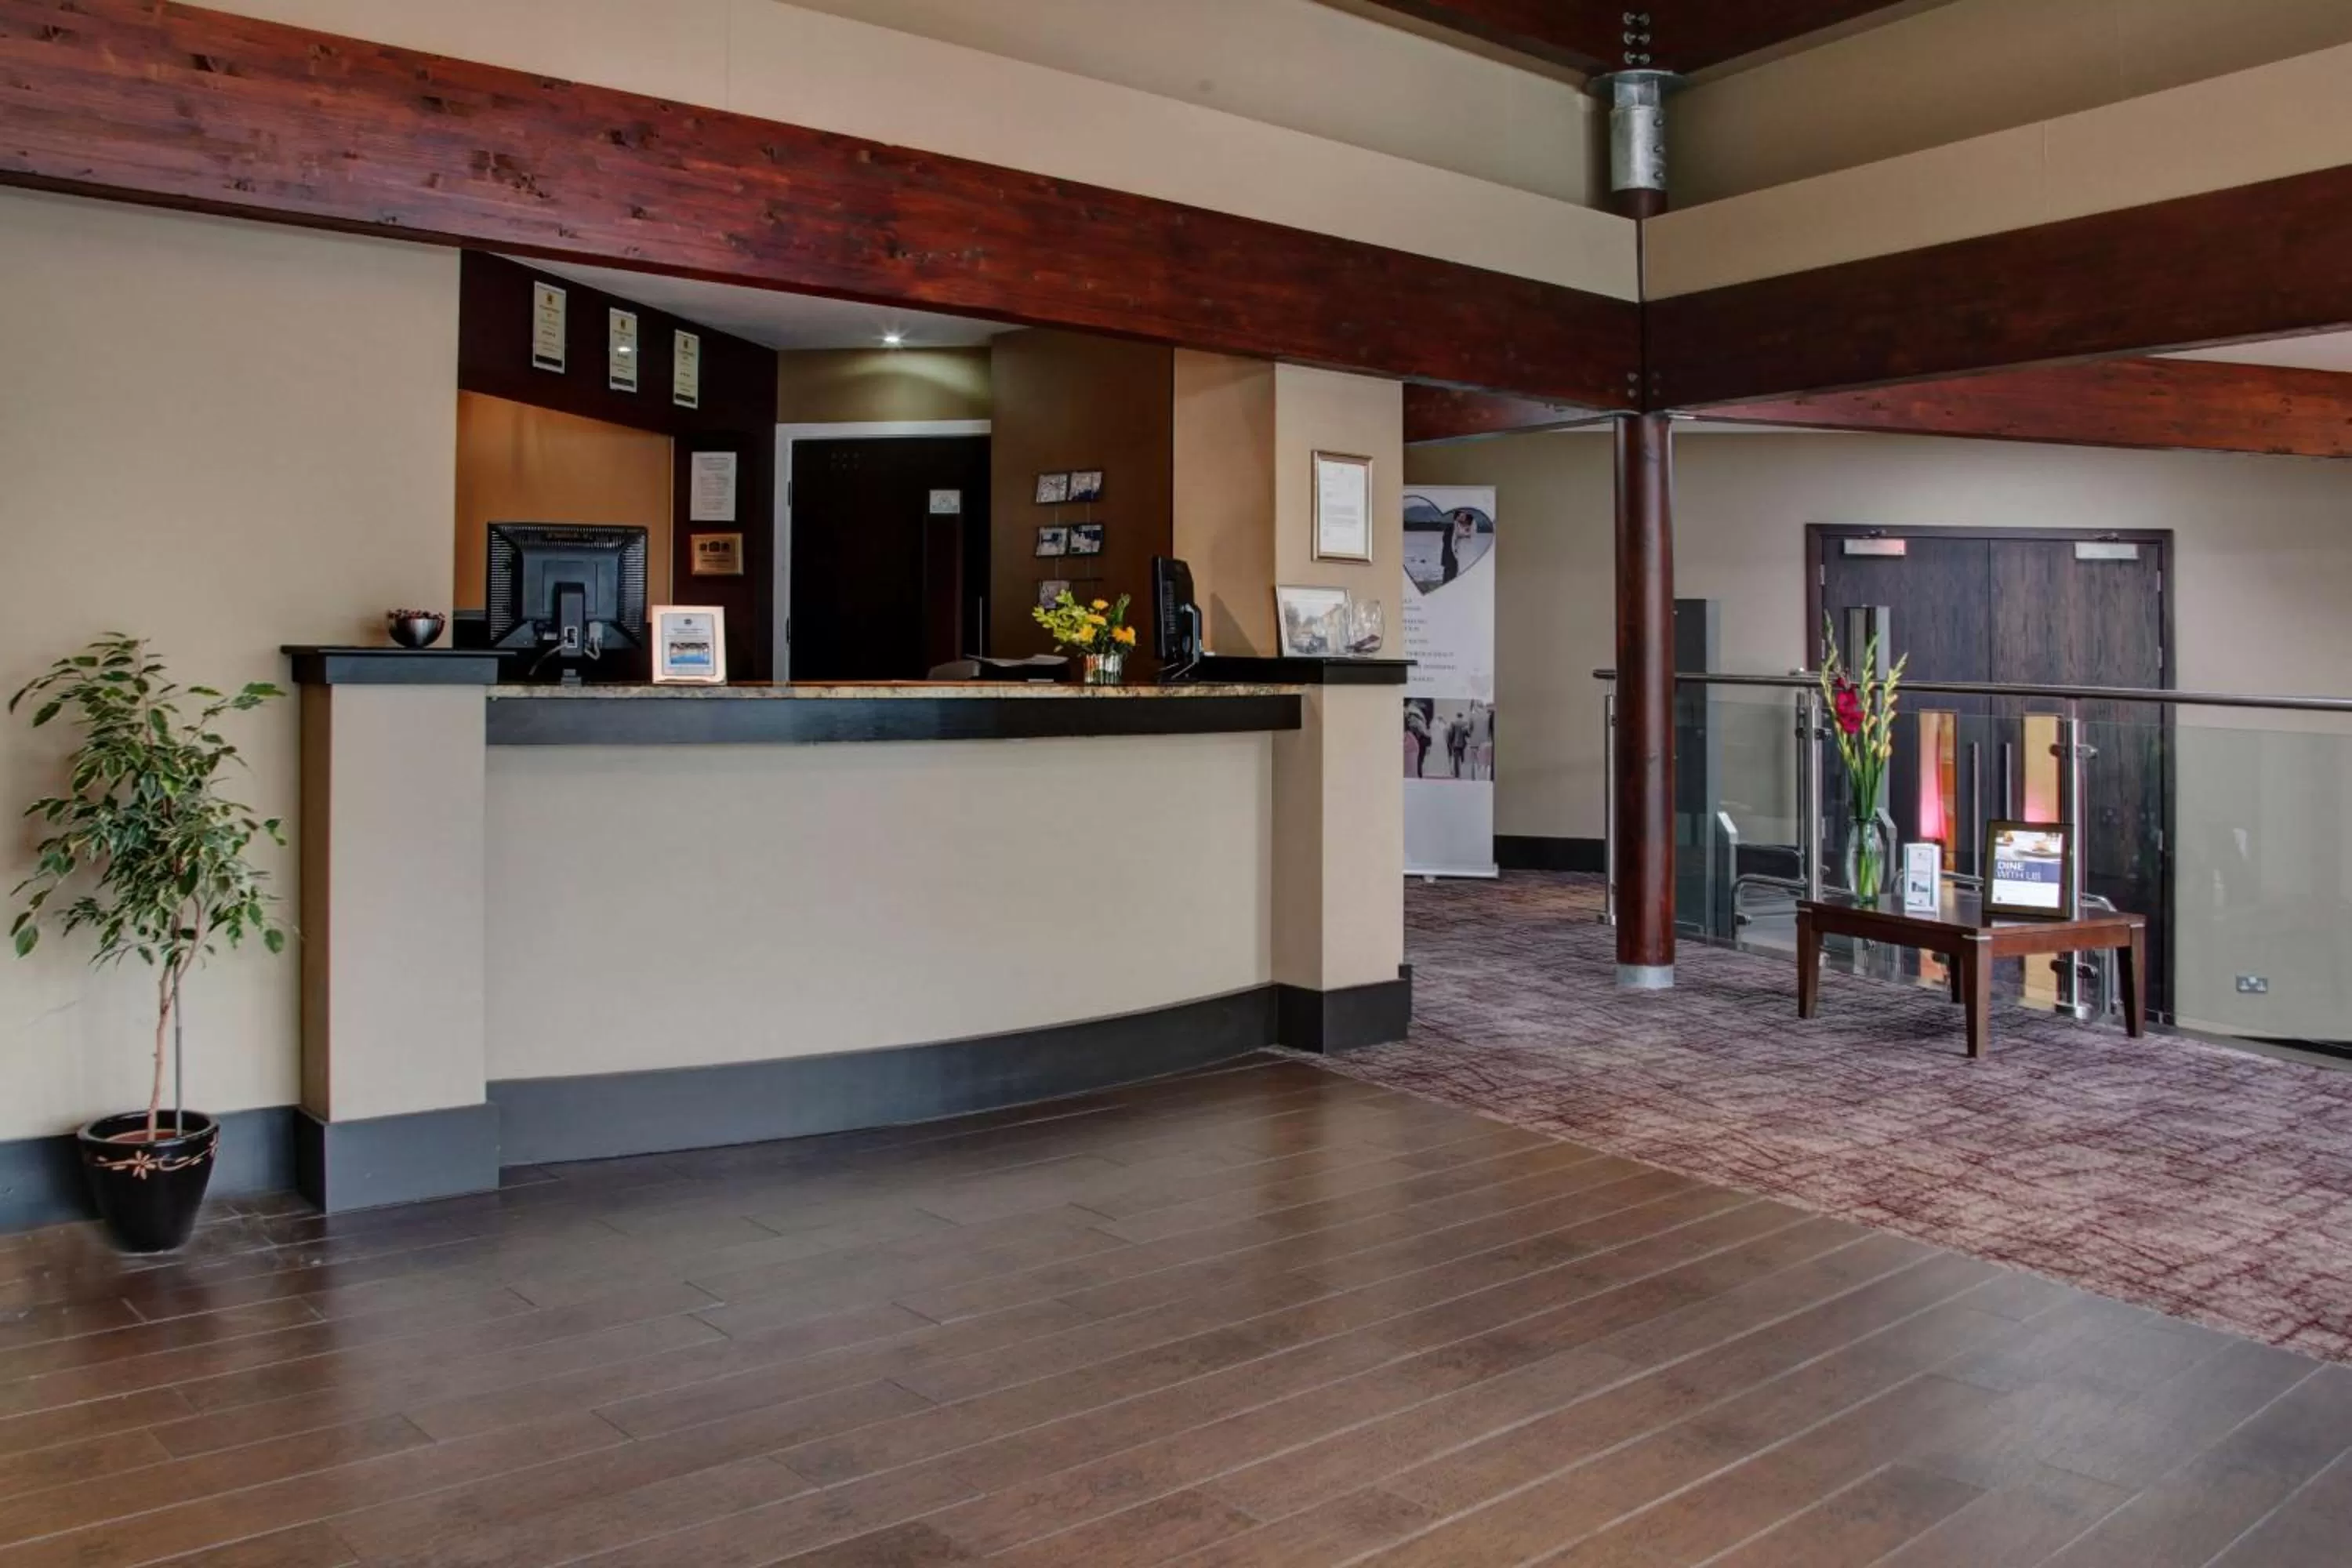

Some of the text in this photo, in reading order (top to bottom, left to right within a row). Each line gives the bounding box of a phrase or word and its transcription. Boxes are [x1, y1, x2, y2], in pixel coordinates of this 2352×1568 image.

[1997, 861, 2025, 871] DINE
[1997, 870, 2040, 880] WITH US
